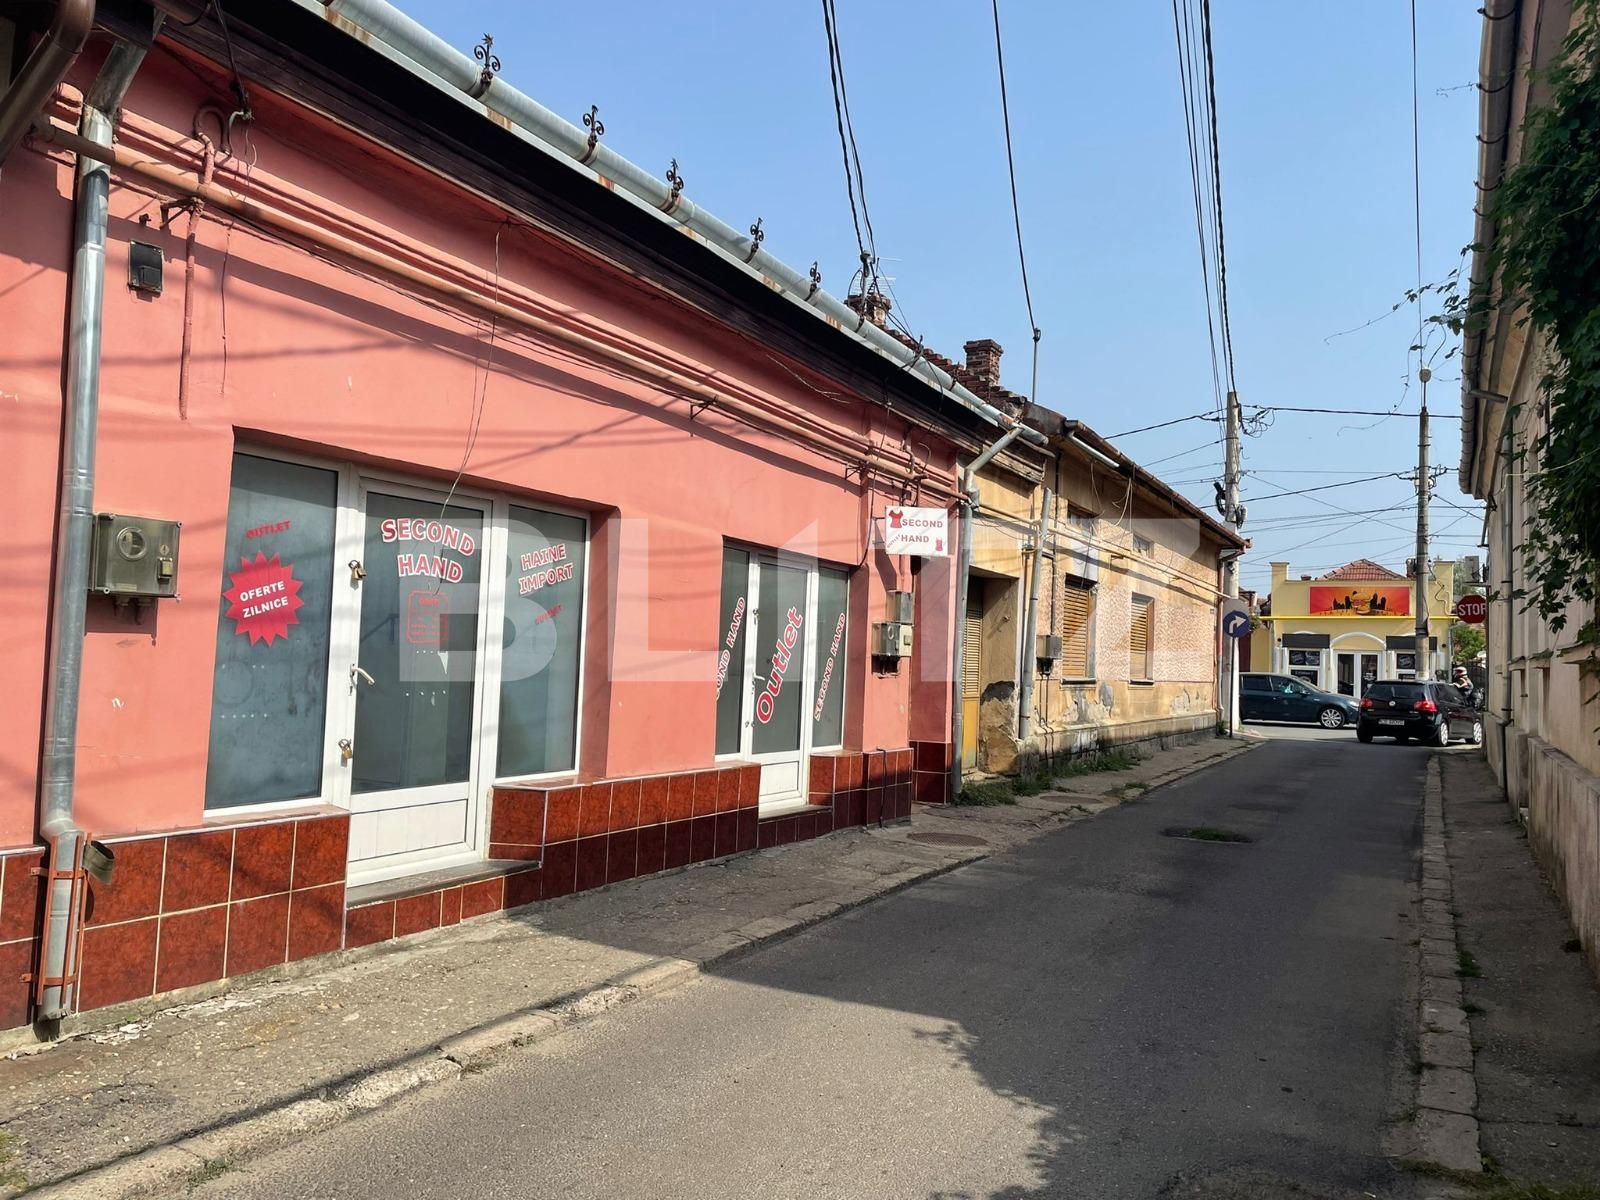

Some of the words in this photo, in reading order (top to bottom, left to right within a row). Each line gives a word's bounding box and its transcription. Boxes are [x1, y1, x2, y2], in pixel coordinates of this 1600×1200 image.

[381, 518, 475, 556] SECOND
[902, 518, 944, 529] SECOND
[901, 534, 930, 544] HAND
[397, 553, 464, 583] HAND
[520, 543, 567, 571] HAINE
[239, 580, 286, 602] OFERTE
[518, 563, 575, 595] IMPORT
[242, 596, 290, 618] ZILNICE
[725, 596, 746, 648] HAND
[756, 606, 804, 724] Outlet
[814, 656, 835, 722] SECOND
[830, 612, 846, 657] HAND
